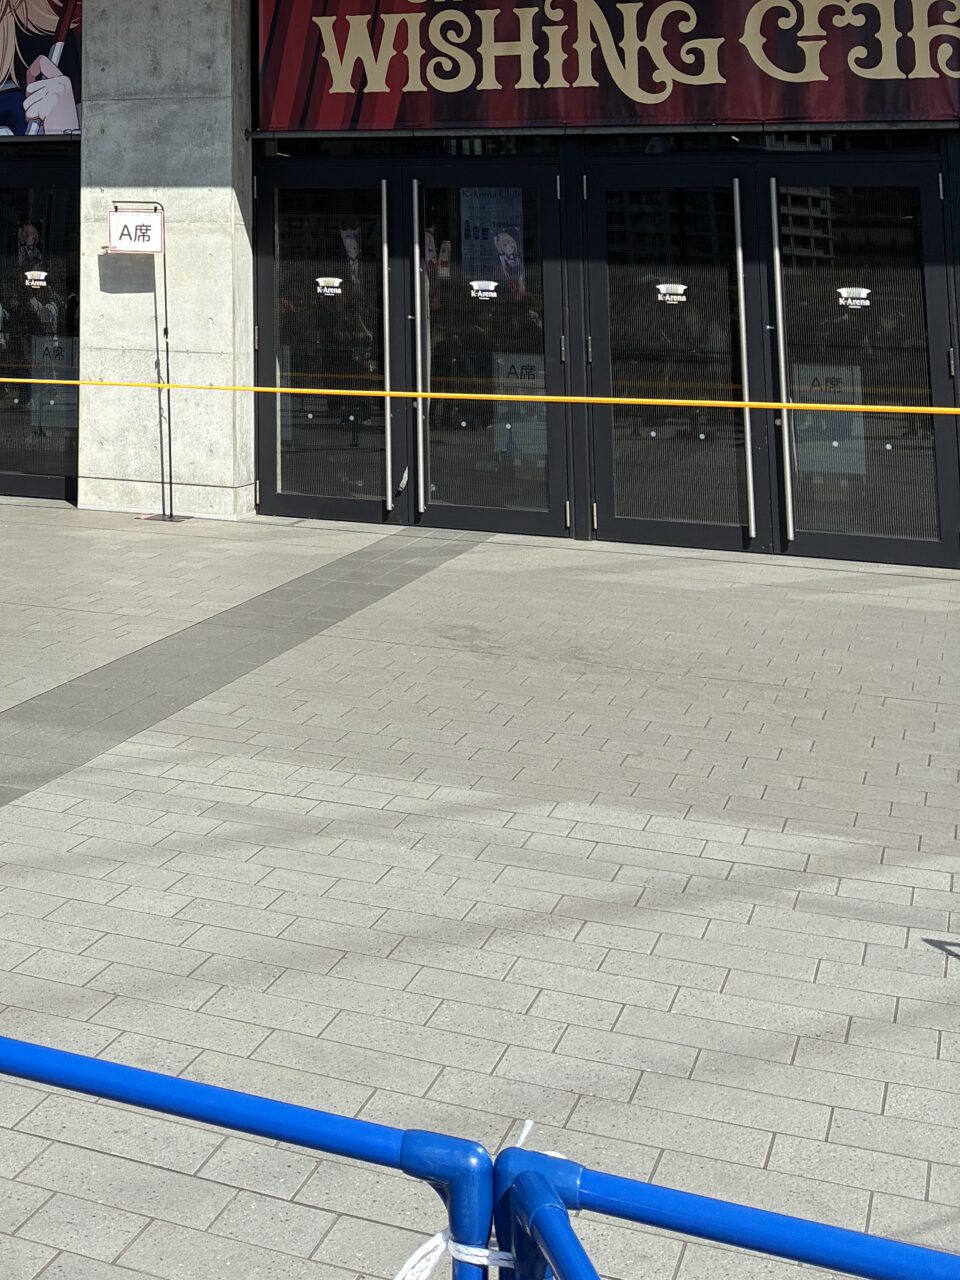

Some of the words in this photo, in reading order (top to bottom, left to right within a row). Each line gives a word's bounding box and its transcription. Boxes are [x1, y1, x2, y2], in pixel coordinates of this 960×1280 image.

[118, 223, 152, 243] A席
[317, 286, 342, 294] K-Arena
[471, 290, 498, 298] K-Arena
[658, 294, 687, 302] K-Arena
[839, 297, 871, 306] K-Arena
